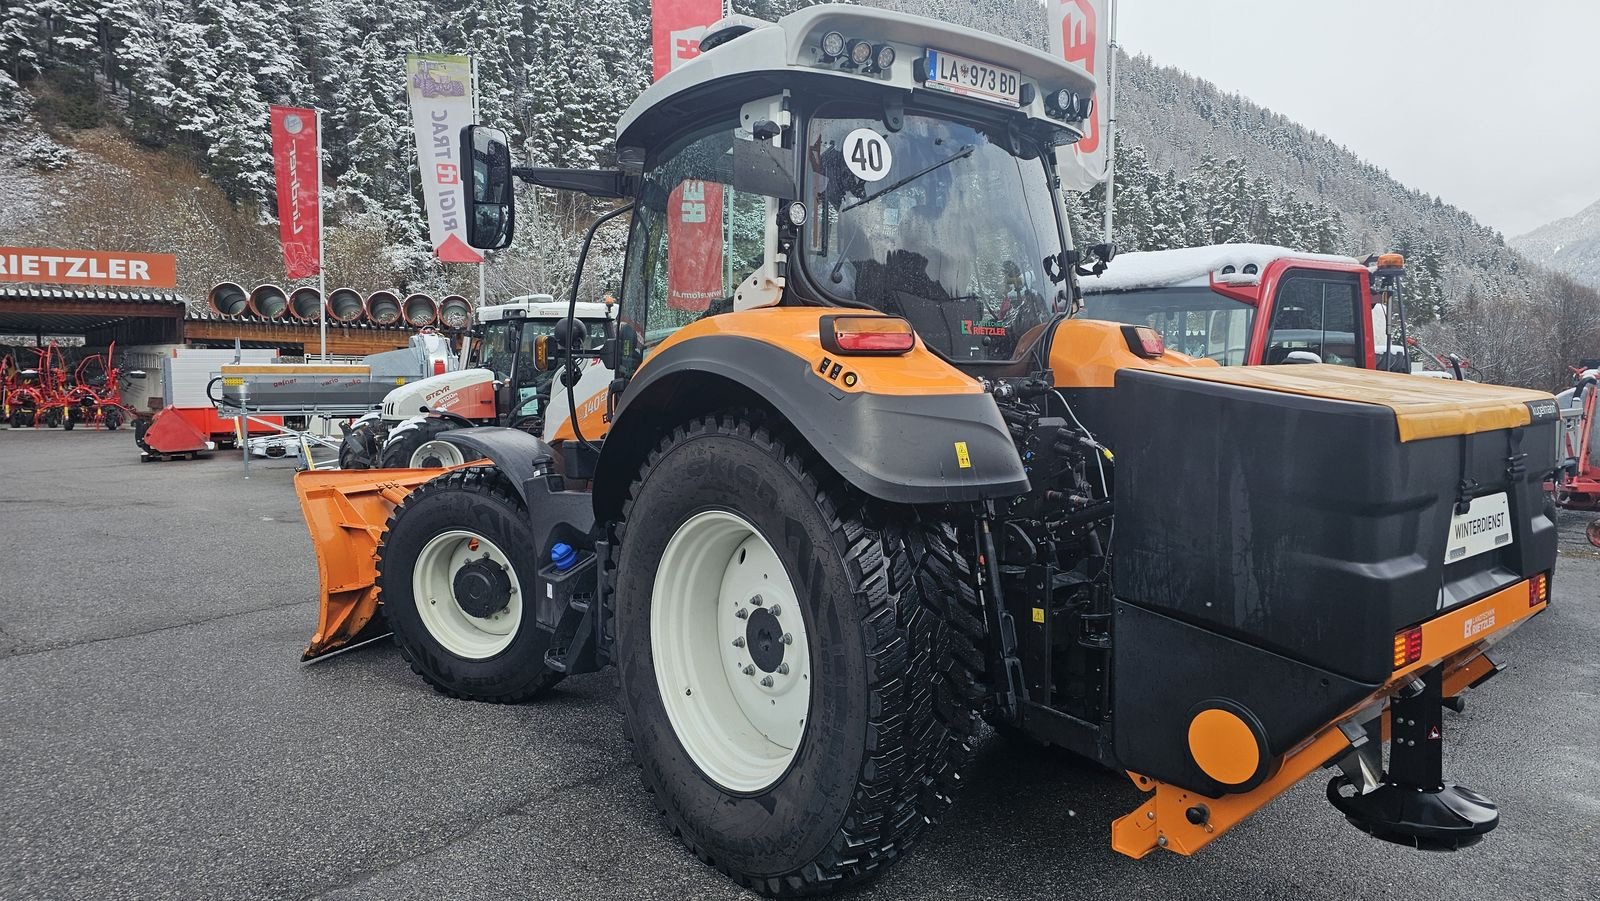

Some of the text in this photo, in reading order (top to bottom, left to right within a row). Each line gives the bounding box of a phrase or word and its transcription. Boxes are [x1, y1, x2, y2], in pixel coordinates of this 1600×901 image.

[929, 69, 935, 77] A
[940, 57, 1016, 96] LA 973 BD
[851, 138, 883, 172] 40
[974, 327, 1006, 336] RIETZLER
[321, 378, 338, 387] vario
[426, 385, 450, 401] STEYR
[1454, 512, 1505, 540] WINTERDIENST
